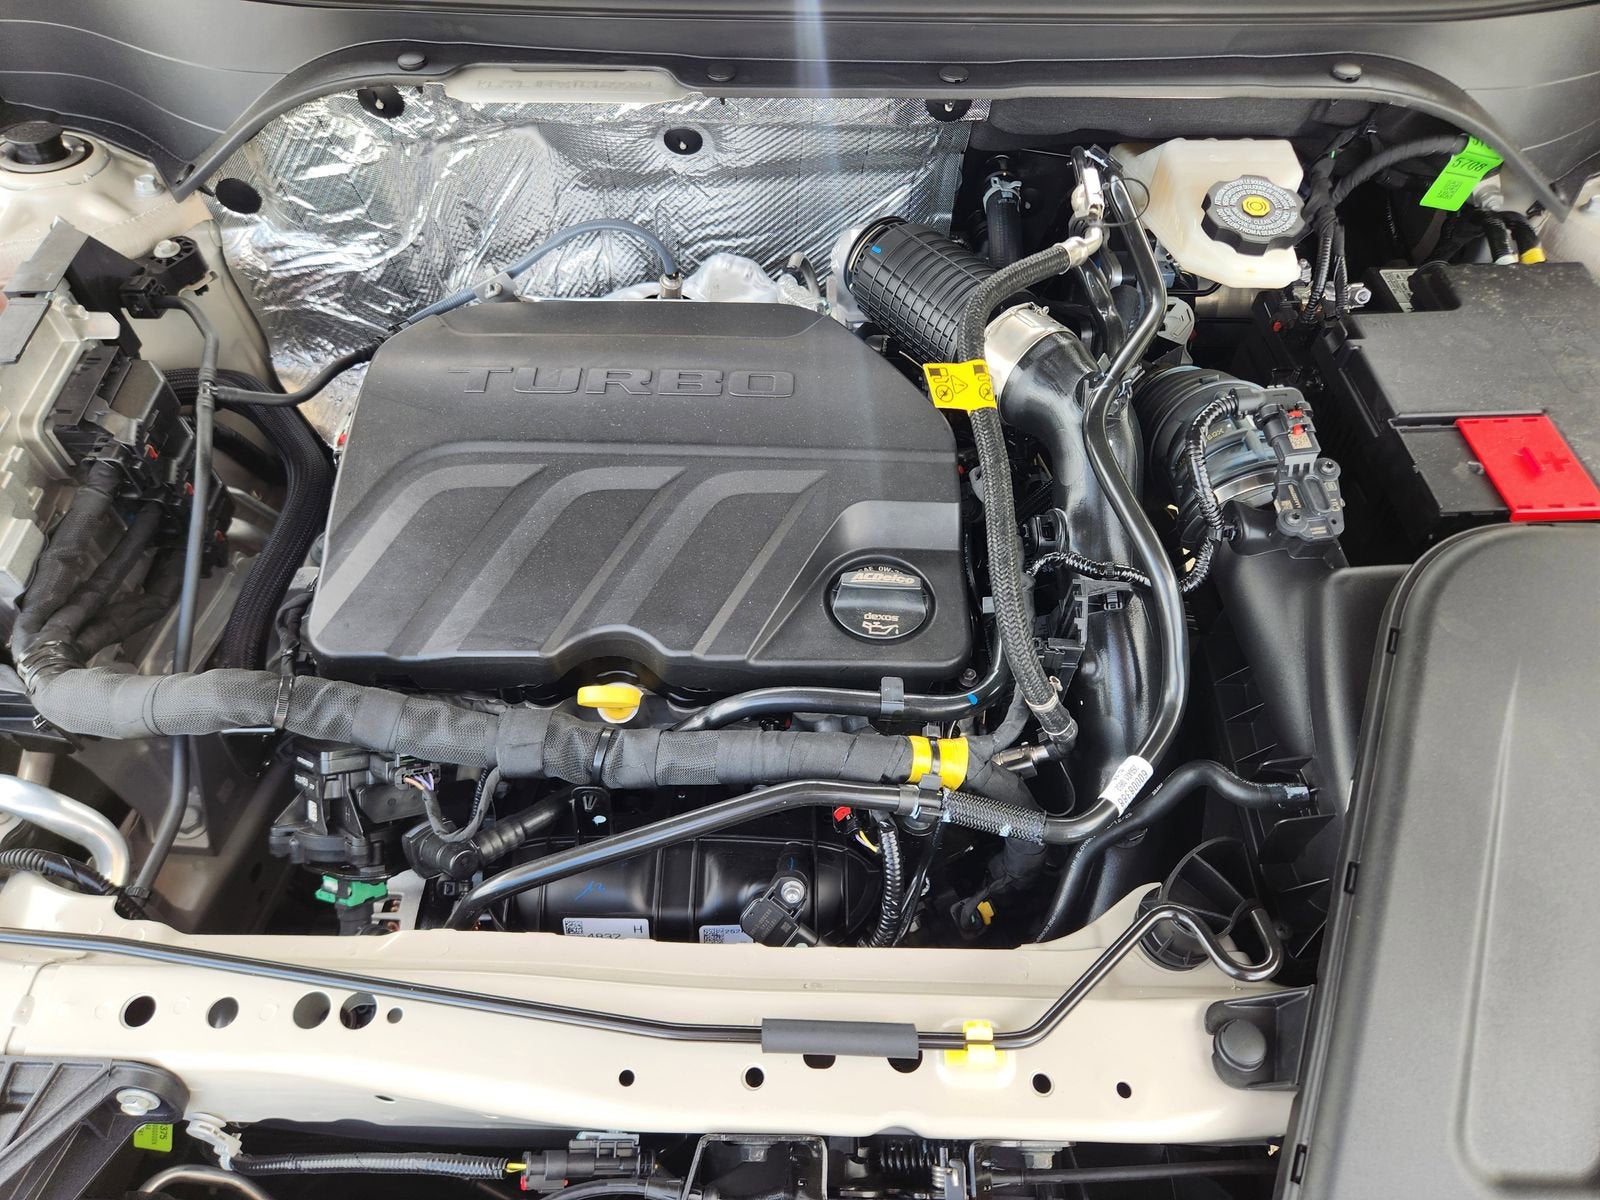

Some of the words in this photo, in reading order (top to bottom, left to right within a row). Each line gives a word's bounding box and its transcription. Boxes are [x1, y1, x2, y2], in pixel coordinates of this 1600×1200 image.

[1452, 157, 1488, 172] 5708
[447, 366, 796, 398] TURBO
[850, 572, 915, 584] ACDelco
[863, 612, 899, 622] dexos
[633, 924, 643, 934] H
[159, 1125, 169, 1140] 375
